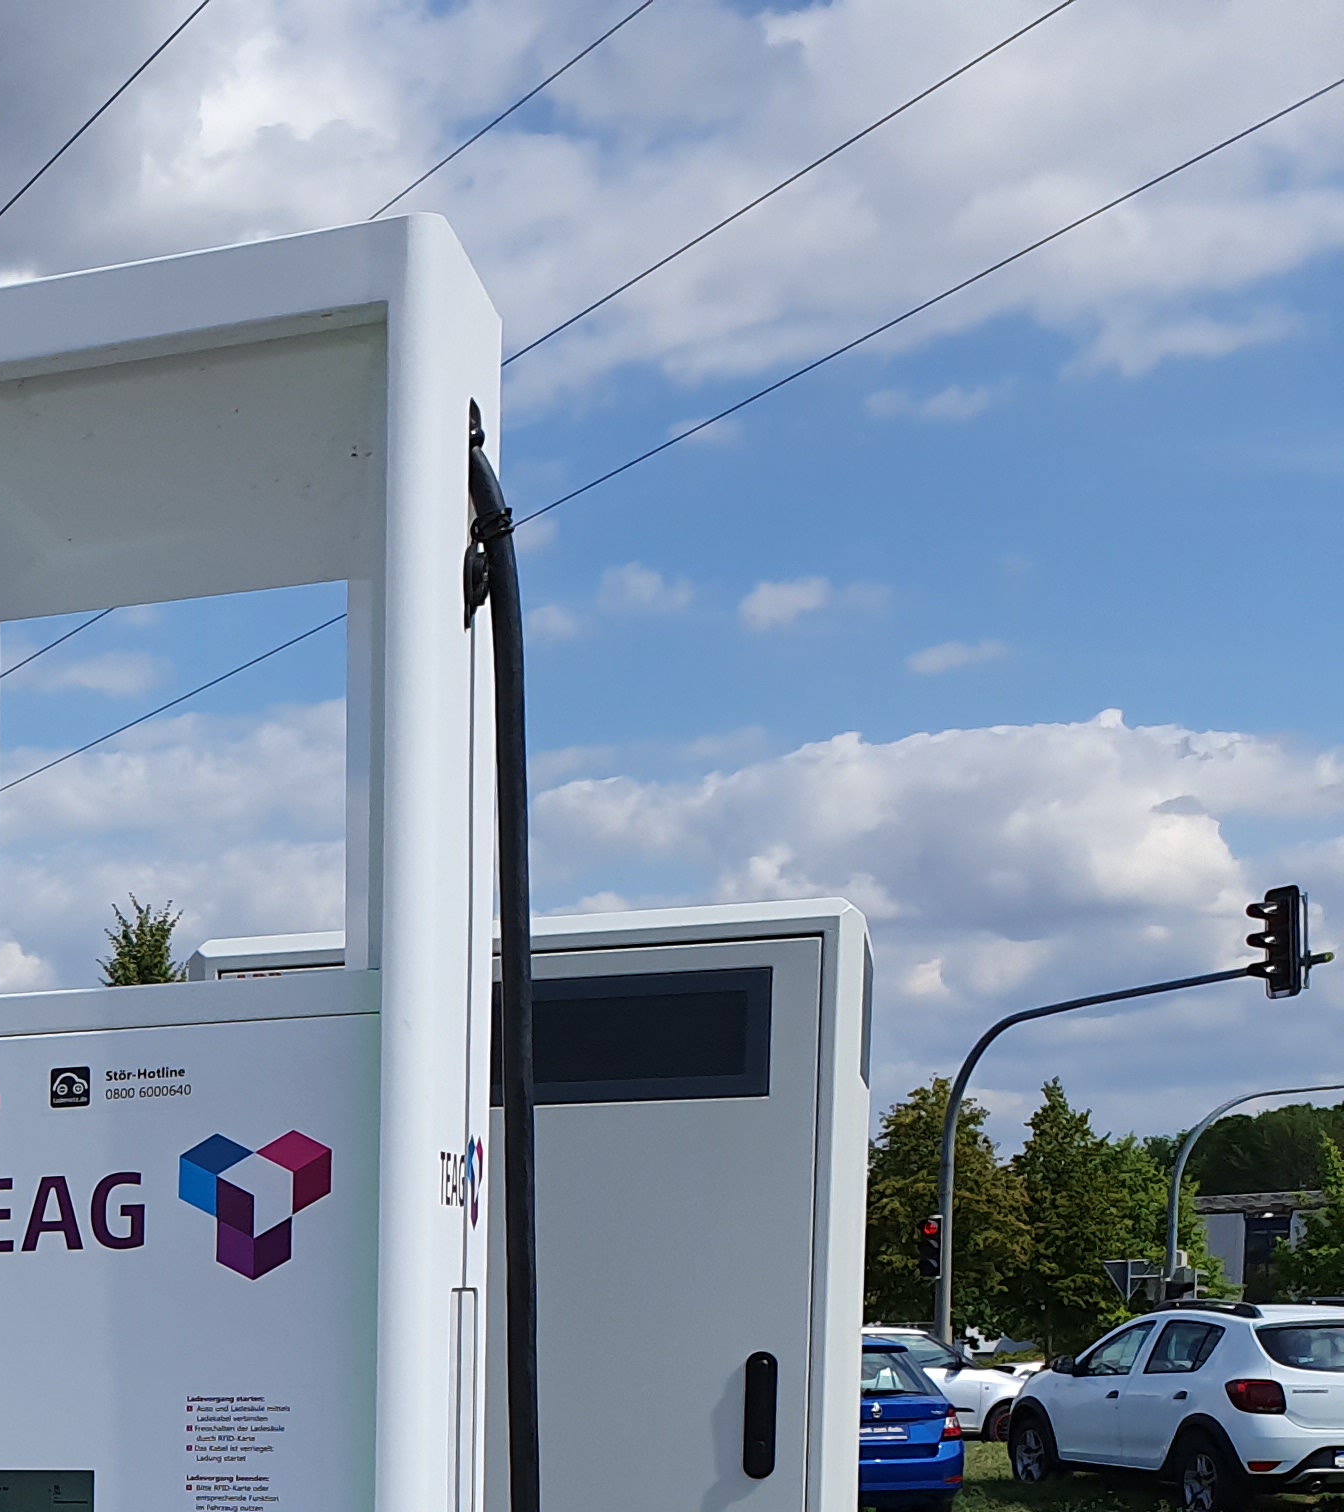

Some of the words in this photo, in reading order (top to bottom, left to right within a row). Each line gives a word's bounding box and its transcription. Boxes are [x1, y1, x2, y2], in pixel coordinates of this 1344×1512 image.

[105, 1066, 186, 1082] Stör-Hotline
[105, 1088, 135, 1100] 0800
[139, 1084, 192, 1098] 6000640
[440, 1151, 466, 1207] TEAG
